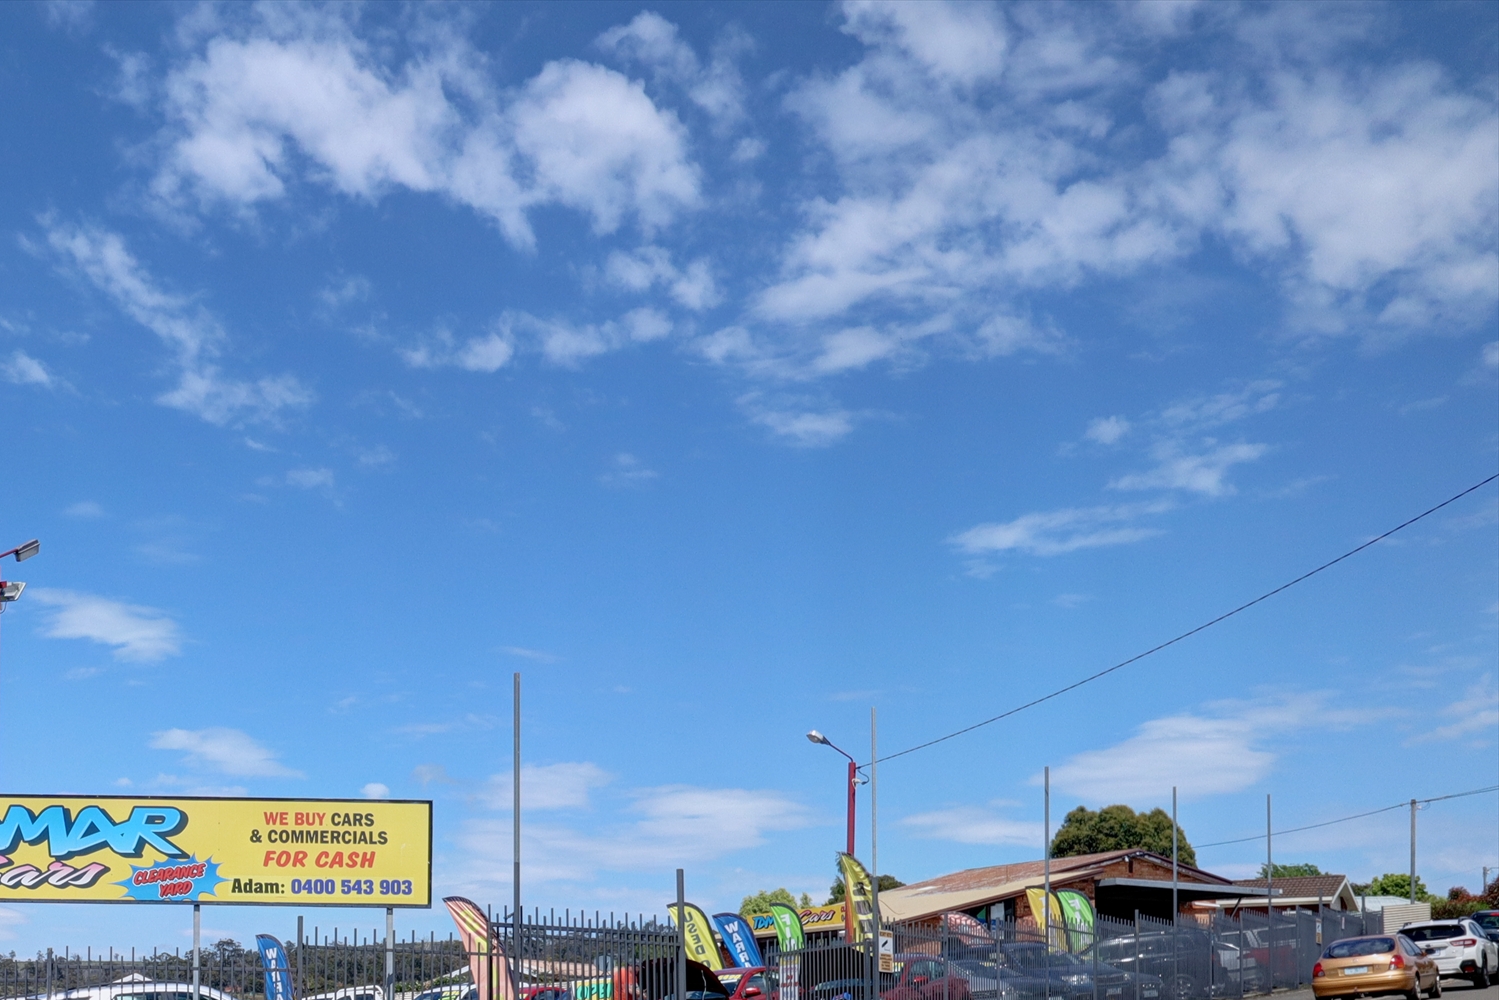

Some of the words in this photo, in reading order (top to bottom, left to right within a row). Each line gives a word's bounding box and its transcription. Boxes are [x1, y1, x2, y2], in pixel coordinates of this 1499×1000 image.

[263, 811, 289, 826] WE
[294, 812, 326, 826] BUY
[330, 812, 375, 827] CARS
[249, 829, 262, 843] &
[267, 829, 388, 845] COMMERCIALS
[262, 850, 308, 868] FOR
[315, 850, 376, 869] CASH
[133, 862, 207, 886] CLEARANCE
[159, 880, 193, 898] YARD
[231, 878, 285, 895] Adam:
[290, 878, 336, 895] 0400
[340, 879, 374, 895] 543
[379, 879, 413, 896] 903
